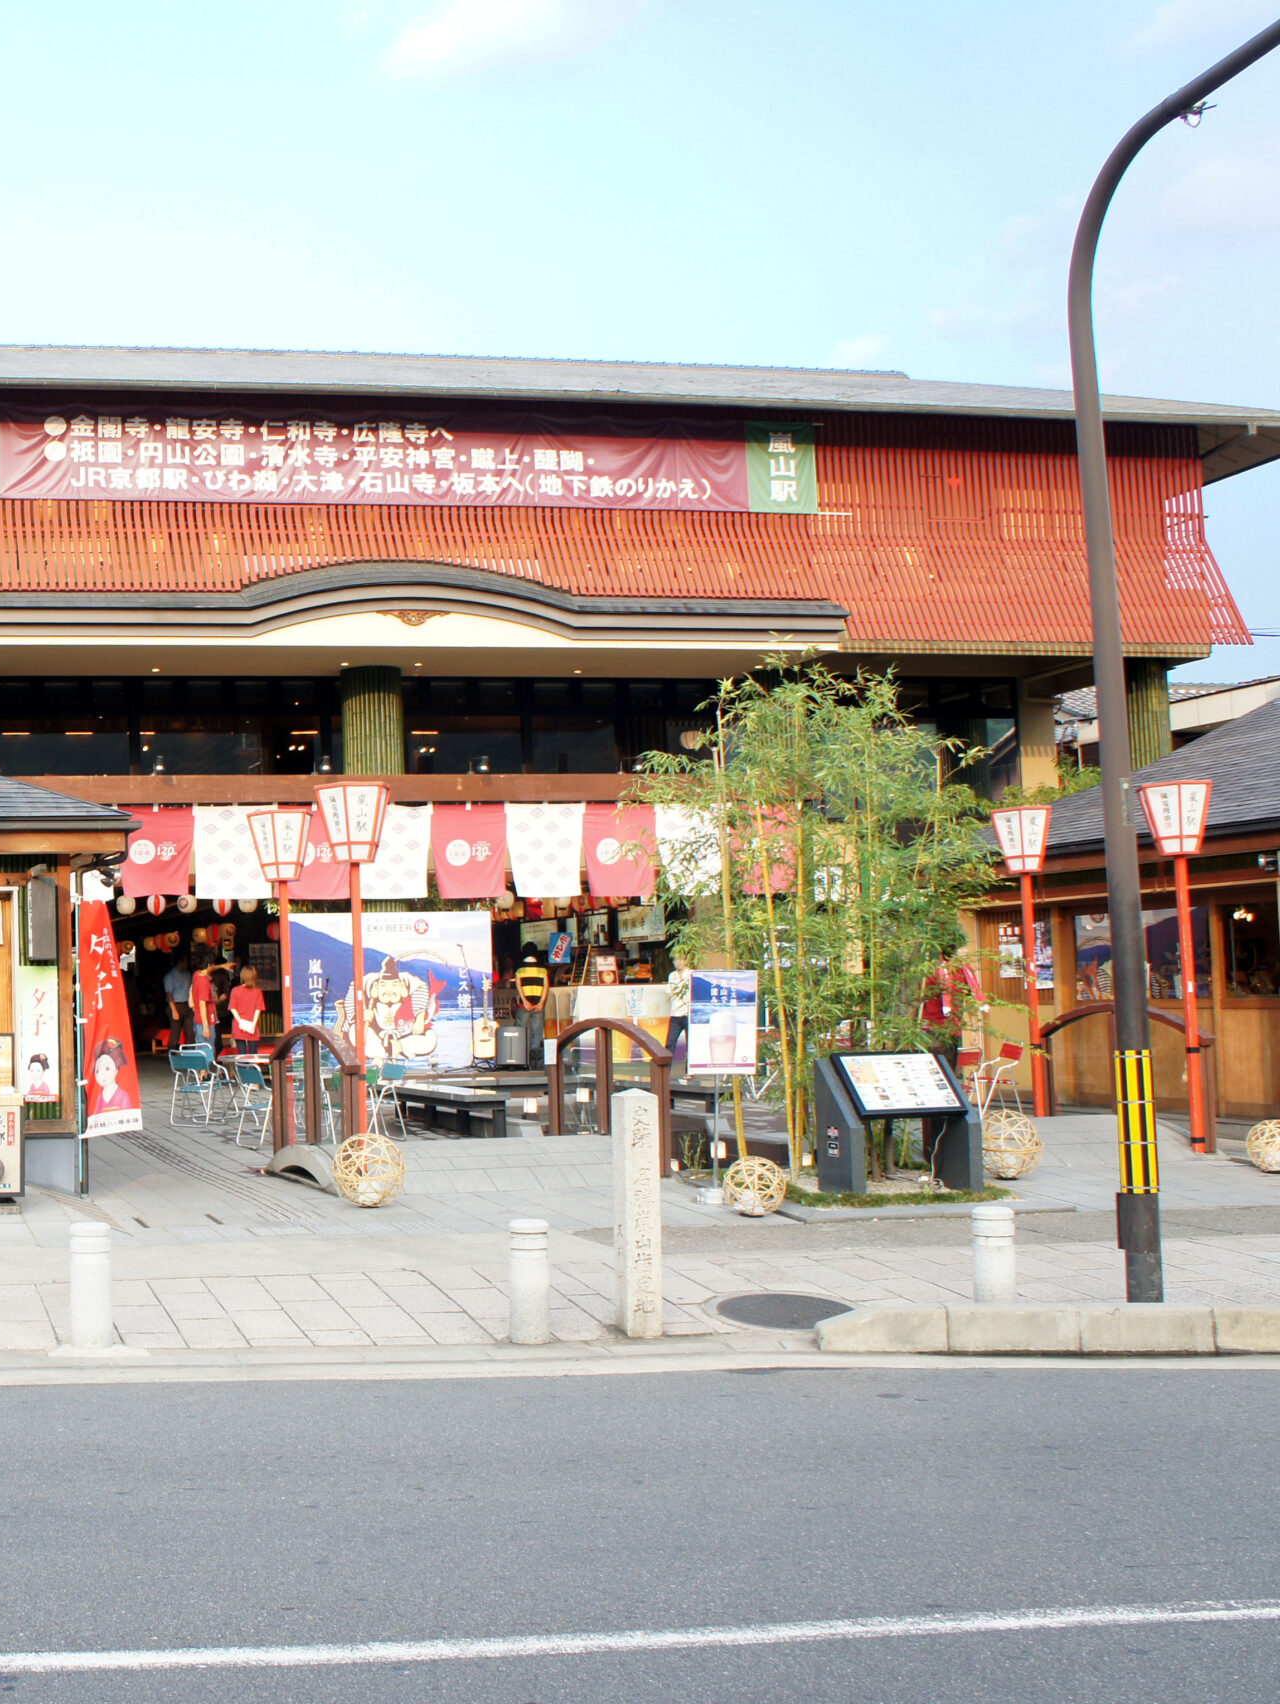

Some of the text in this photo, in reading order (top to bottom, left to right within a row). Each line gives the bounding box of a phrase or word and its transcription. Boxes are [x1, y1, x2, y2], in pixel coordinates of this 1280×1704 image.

[767, 431, 799, 503] 嵐山駅
[29, 988, 47, 1036] 夕子
